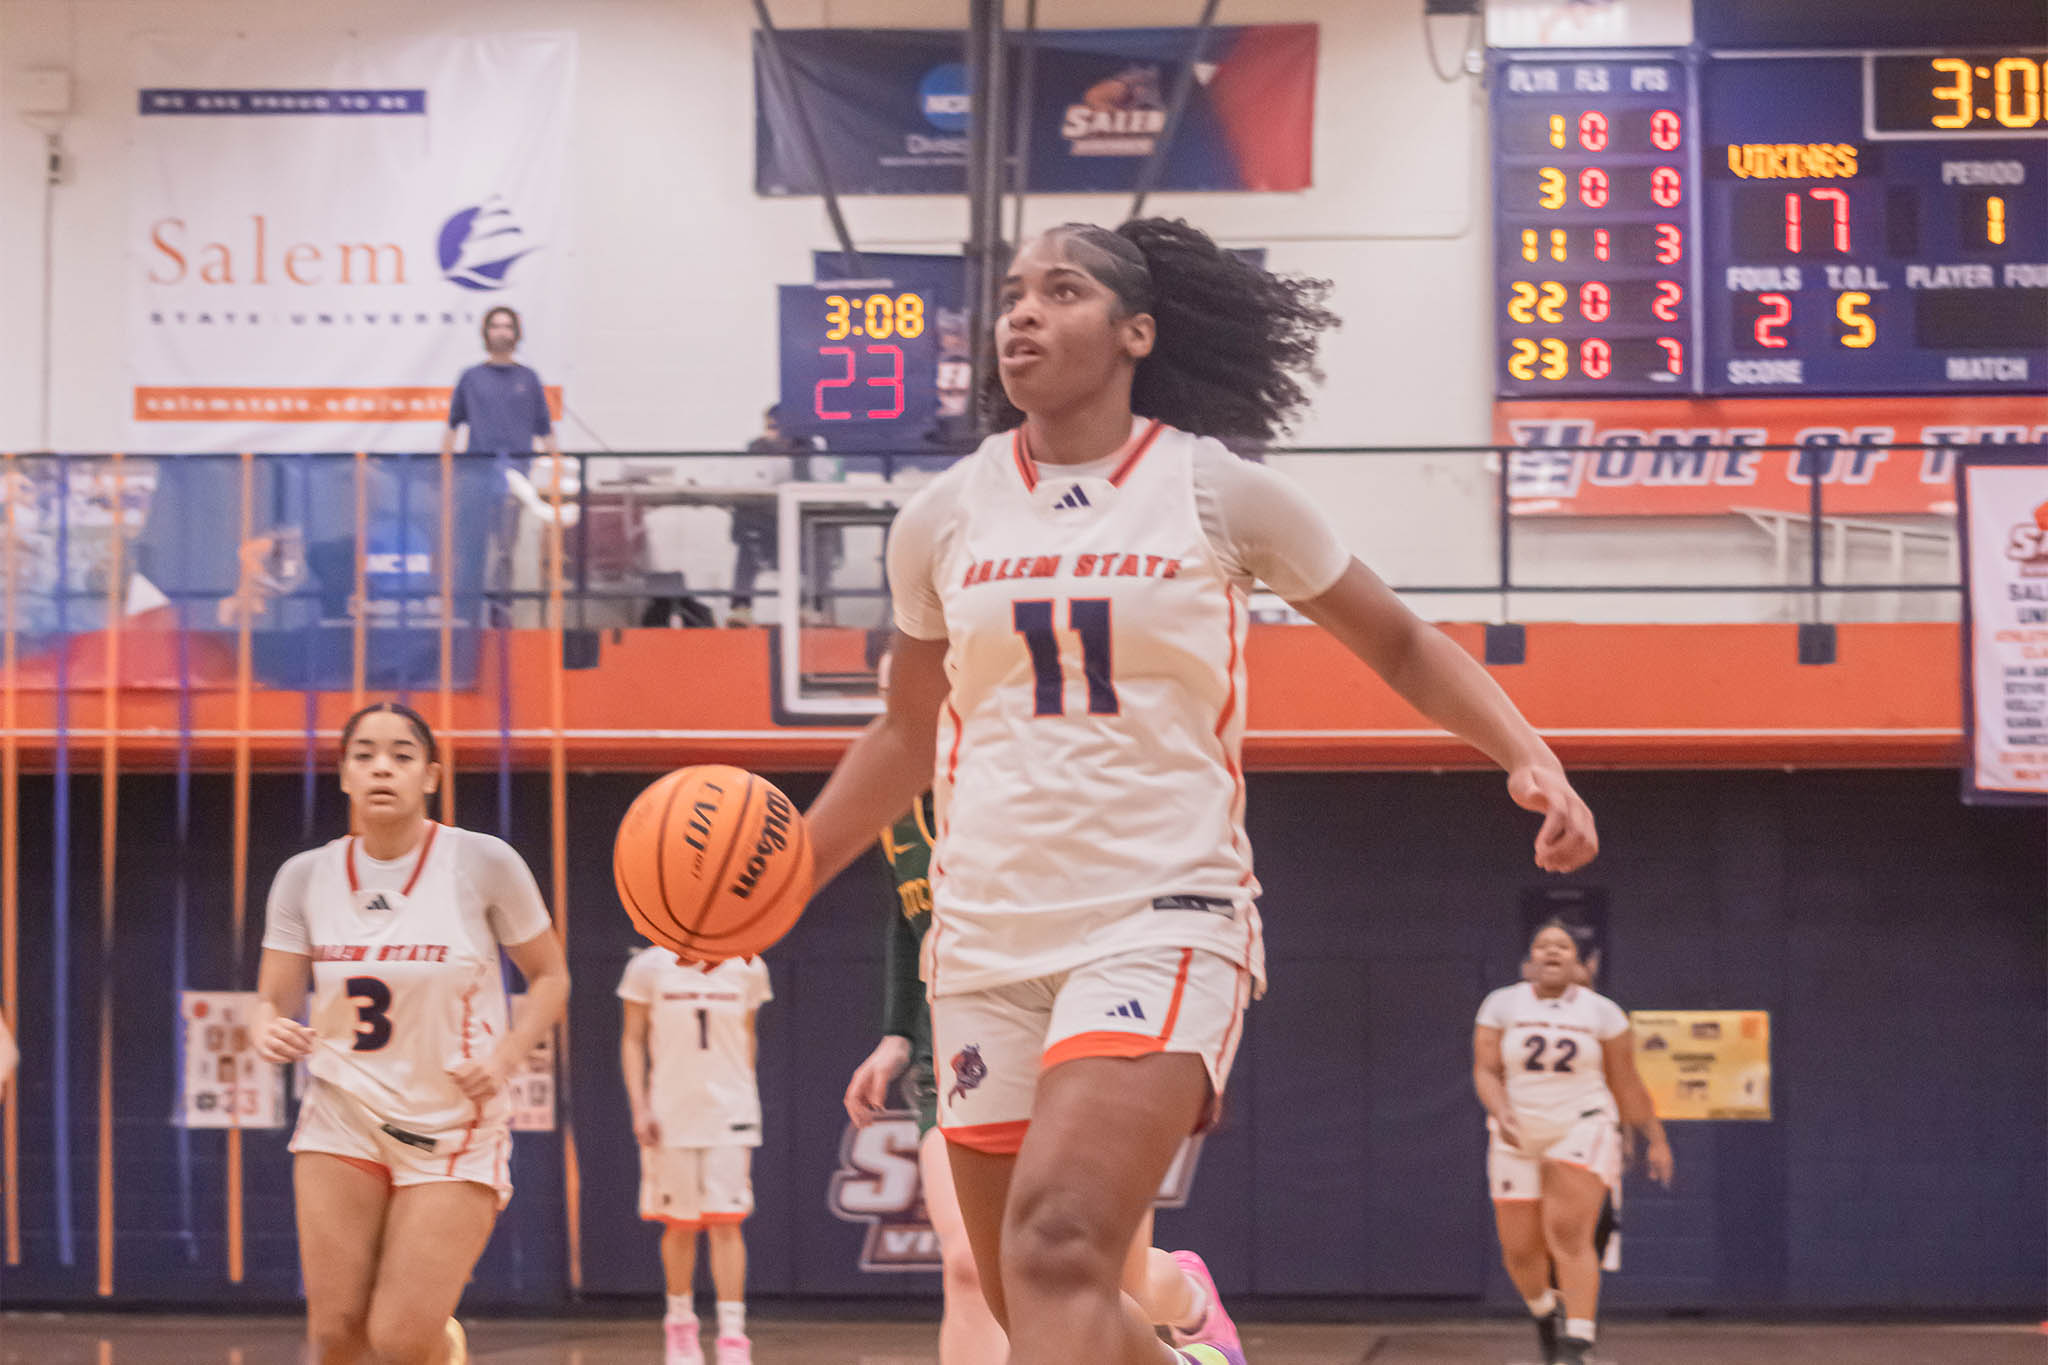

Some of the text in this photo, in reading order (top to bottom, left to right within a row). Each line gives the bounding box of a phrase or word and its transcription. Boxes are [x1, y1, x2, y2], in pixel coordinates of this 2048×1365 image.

[1931, 57, 2048, 129] 3:0
[1549, 109, 1681, 152] 1 0 0
[1538, 166, 1682, 210] 3 0 0
[1941, 161, 2025, 185] PERIOD
[1785, 187, 1850, 253] 17
[1987, 196, 2005, 245] 1
[147, 214, 409, 287] Salem
[1521, 223, 1682, 265] 11 1 3
[1726, 266, 1802, 291] FOULS
[1906, 264, 2048, 288] PLAYER FOU
[290, 313, 474, 325] UNIVERSI
[825, 292, 925, 341] 3:08
[1508, 280, 1683, 324] 22 0 2
[1754, 293, 1792, 349] 2
[1836, 292, 1877, 348] 5
[1508, 338, 1569, 381] 23
[1580, 337, 1612, 379] 0
[1728, 359, 1803, 384] SCORE
[814, 345, 905, 420] 23
[1786, 426, 1896, 485] OF
[1073, 551, 1183, 579] STATE
[1011, 597, 1121, 719] 11
[344, 975, 393, 1053] 3
[695, 1007, 710, 1051] 1
[1523, 1034, 1578, 1073] 22
